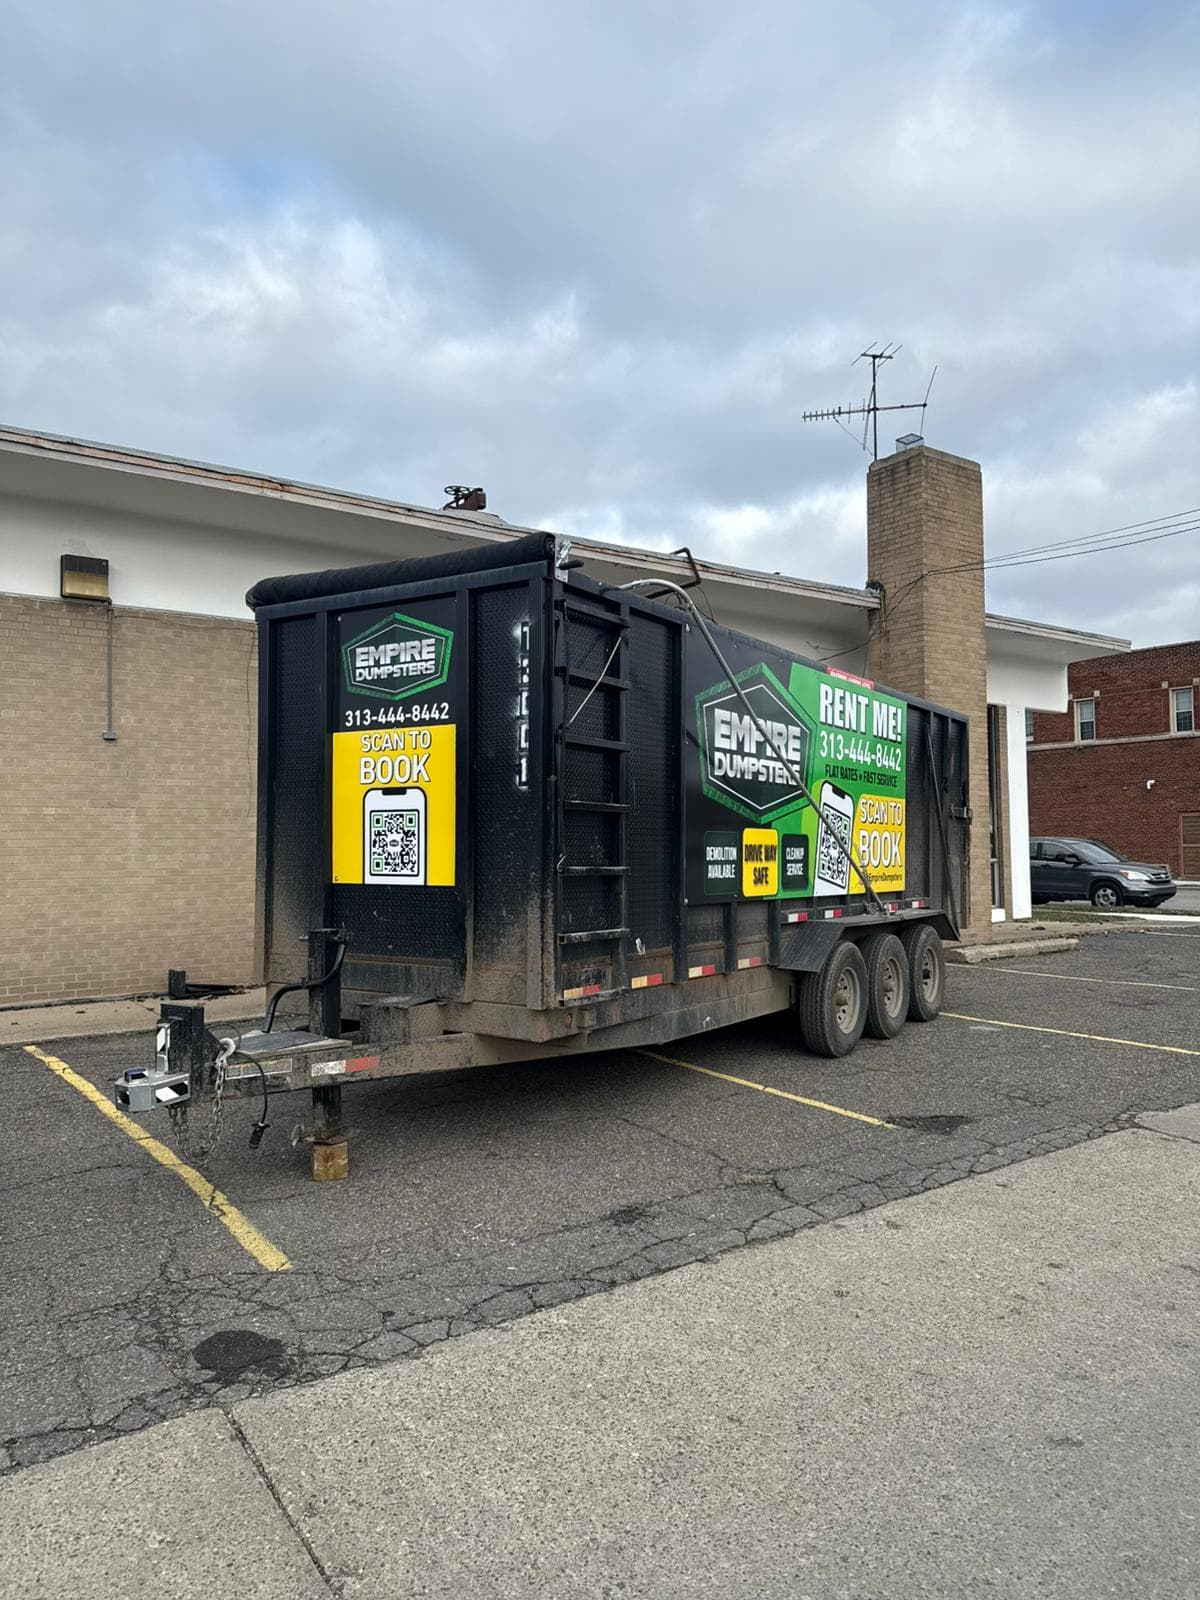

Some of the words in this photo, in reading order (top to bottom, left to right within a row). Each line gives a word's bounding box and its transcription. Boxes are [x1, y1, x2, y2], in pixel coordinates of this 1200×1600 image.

[355, 638, 436, 667] EMPIRE
[355, 660, 436, 681] DUMPSTERS
[345, 702, 449, 727] 313-444-8442
[820, 682, 868, 734] RENT
[872, 700, 903, 744] ME!
[361, 732, 405, 752] SCAN
[409, 730, 432, 750] TO
[714, 708, 801, 762] EMPIRE
[820, 730, 901, 772] 313-444-8442
[360, 753, 431, 785] BOOK
[714, 752, 801, 785] DUMPSTERS
[825, 764, 839, 779] FLAT
[840, 766, 858, 781] RATES
[863, 770, 876, 784] FAST
[877, 773, 897, 787] SERVICE
[860, 798, 887, 825] SCAN
[889, 801, 902, 826] TO
[706, 847, 737, 860] DEMOLITION
[744, 844, 762, 862] DRIVE
[764, 844, 777, 862] WAY
[786, 847, 804, 860] CLEANUP
[859, 829, 902, 868] BOOK
[708, 864, 735, 878] AVAILABLE
[753, 867, 769, 885] SAFE
[786, 863, 803, 876] SERVICE
